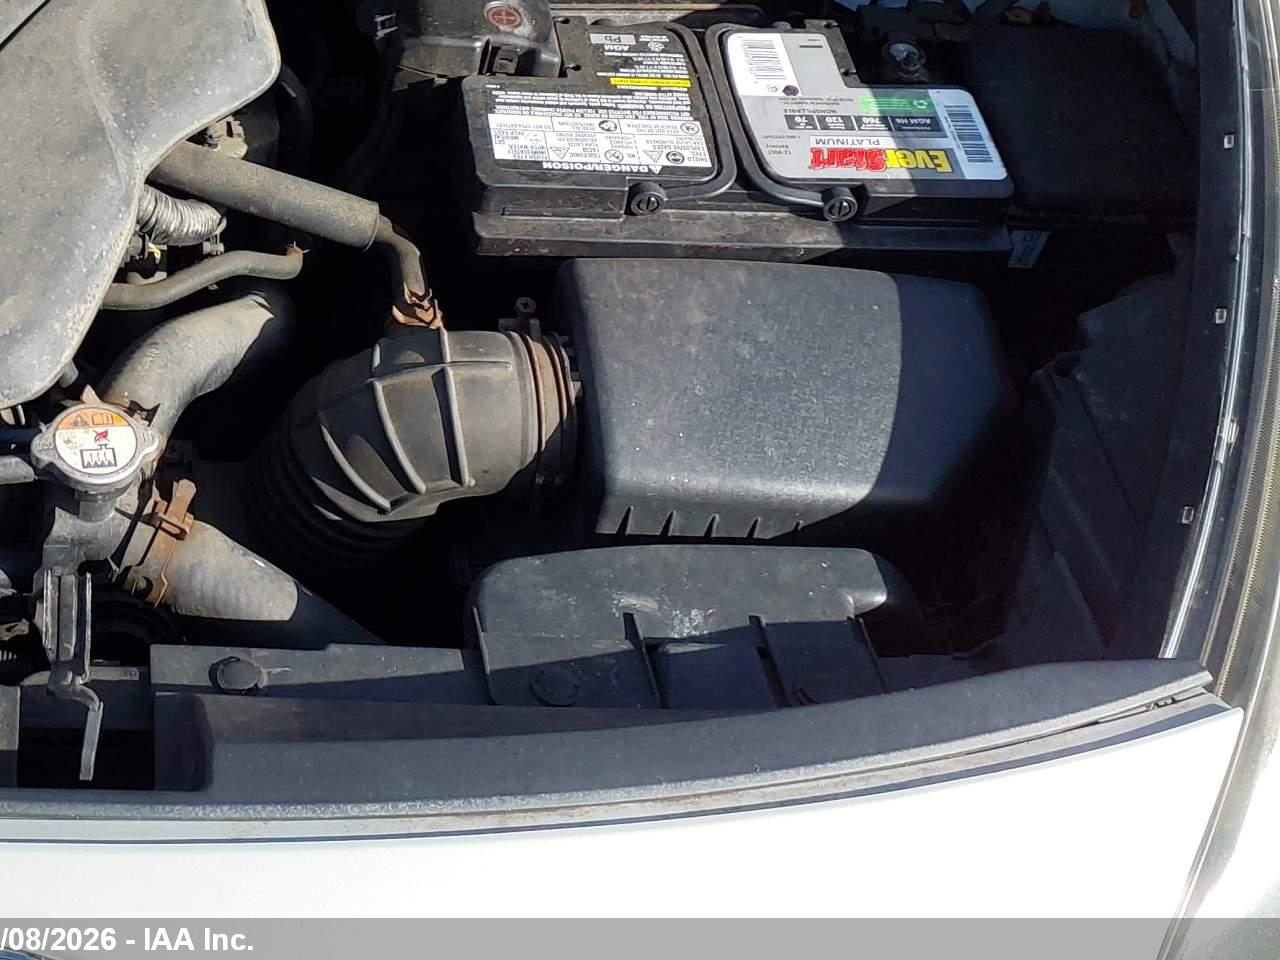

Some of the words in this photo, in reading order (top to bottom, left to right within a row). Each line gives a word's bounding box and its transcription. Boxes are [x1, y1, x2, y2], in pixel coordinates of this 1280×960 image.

[794, 116, 808, 124] 70
[826, 116, 844, 124] 120
[862, 116, 881, 124] 760
[814, 137, 880, 146] PLATINUM
[810, 147, 953, 173] EverStart
[542, 162, 649, 172] DANGER/POISON
